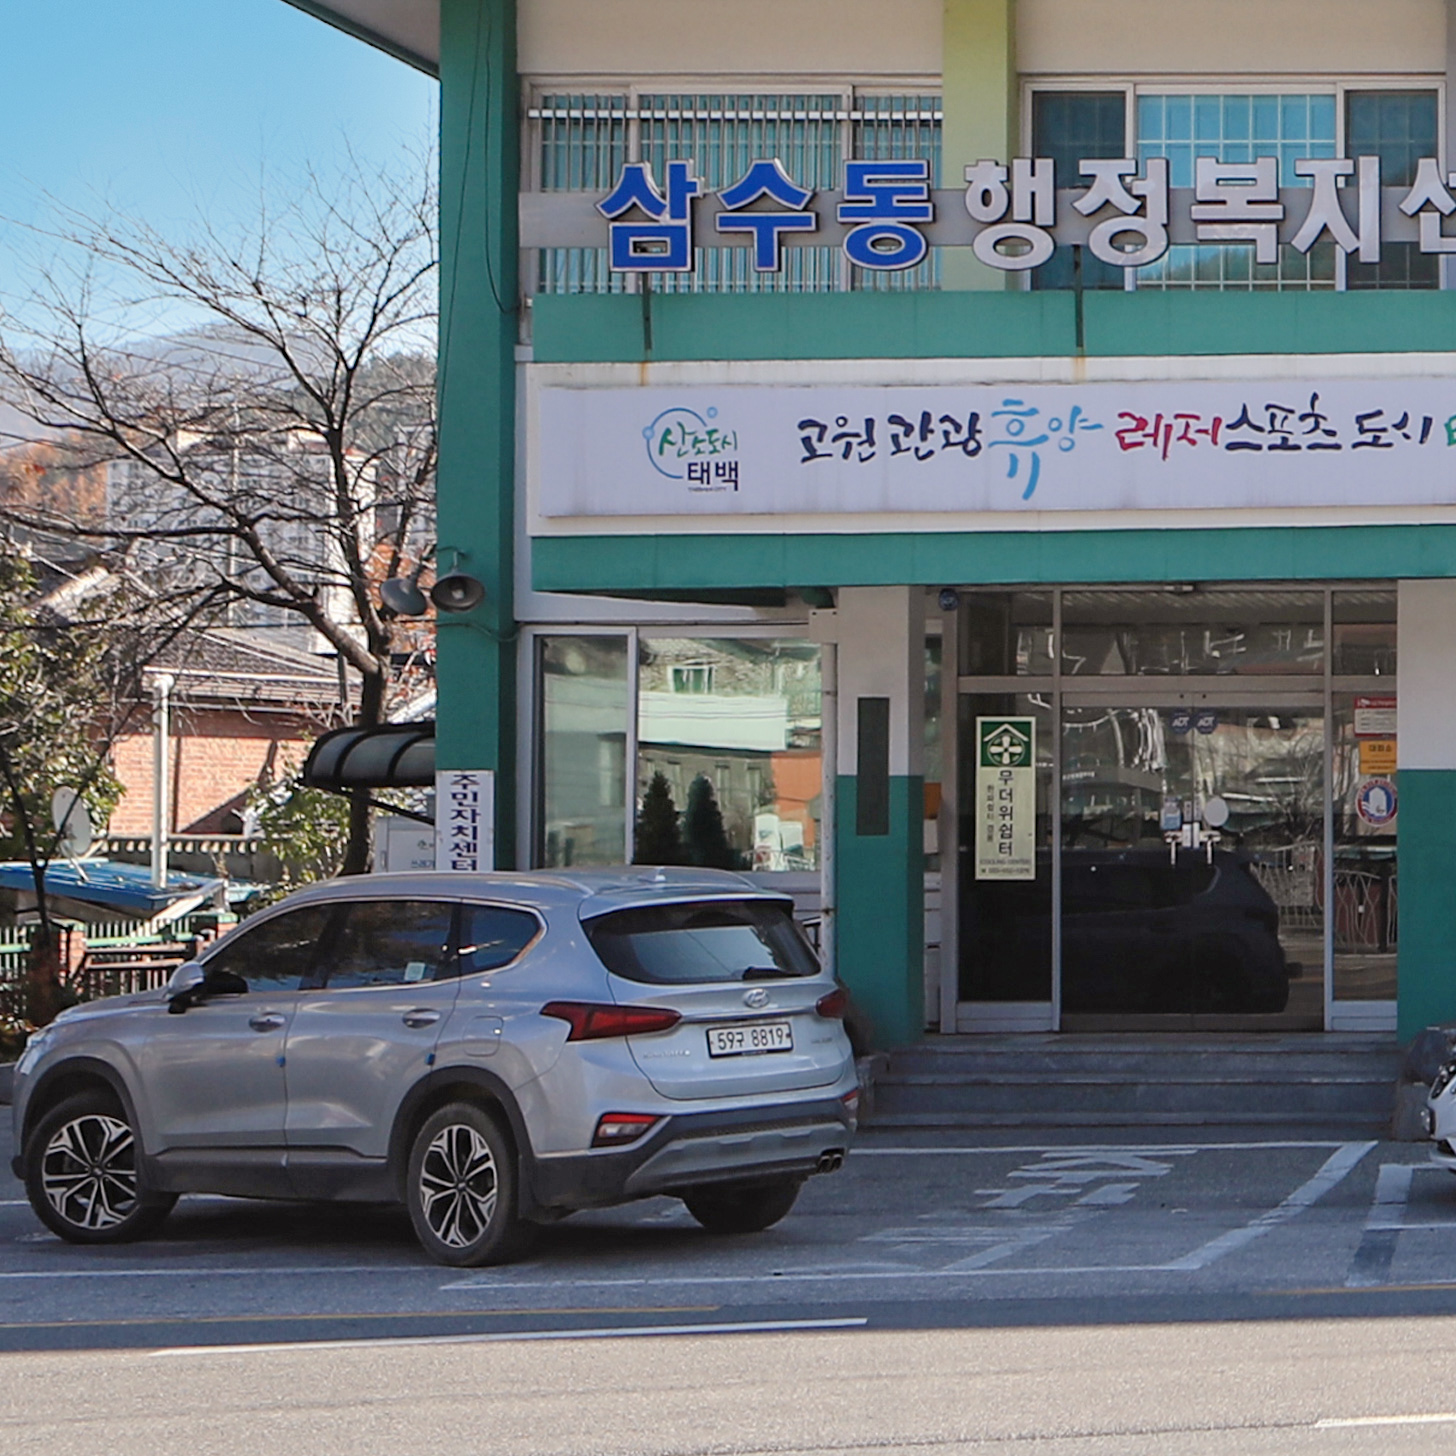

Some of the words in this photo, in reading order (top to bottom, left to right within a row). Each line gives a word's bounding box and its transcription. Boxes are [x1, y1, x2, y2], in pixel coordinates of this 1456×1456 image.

[595, 158, 935, 273] 삼수동
[687, 460, 738, 492] 태백
[449, 774, 482, 871] 주민자치센터
[998, 769, 1014, 857] 무더위쉼터
[751, 1027, 784, 1047] 8819
